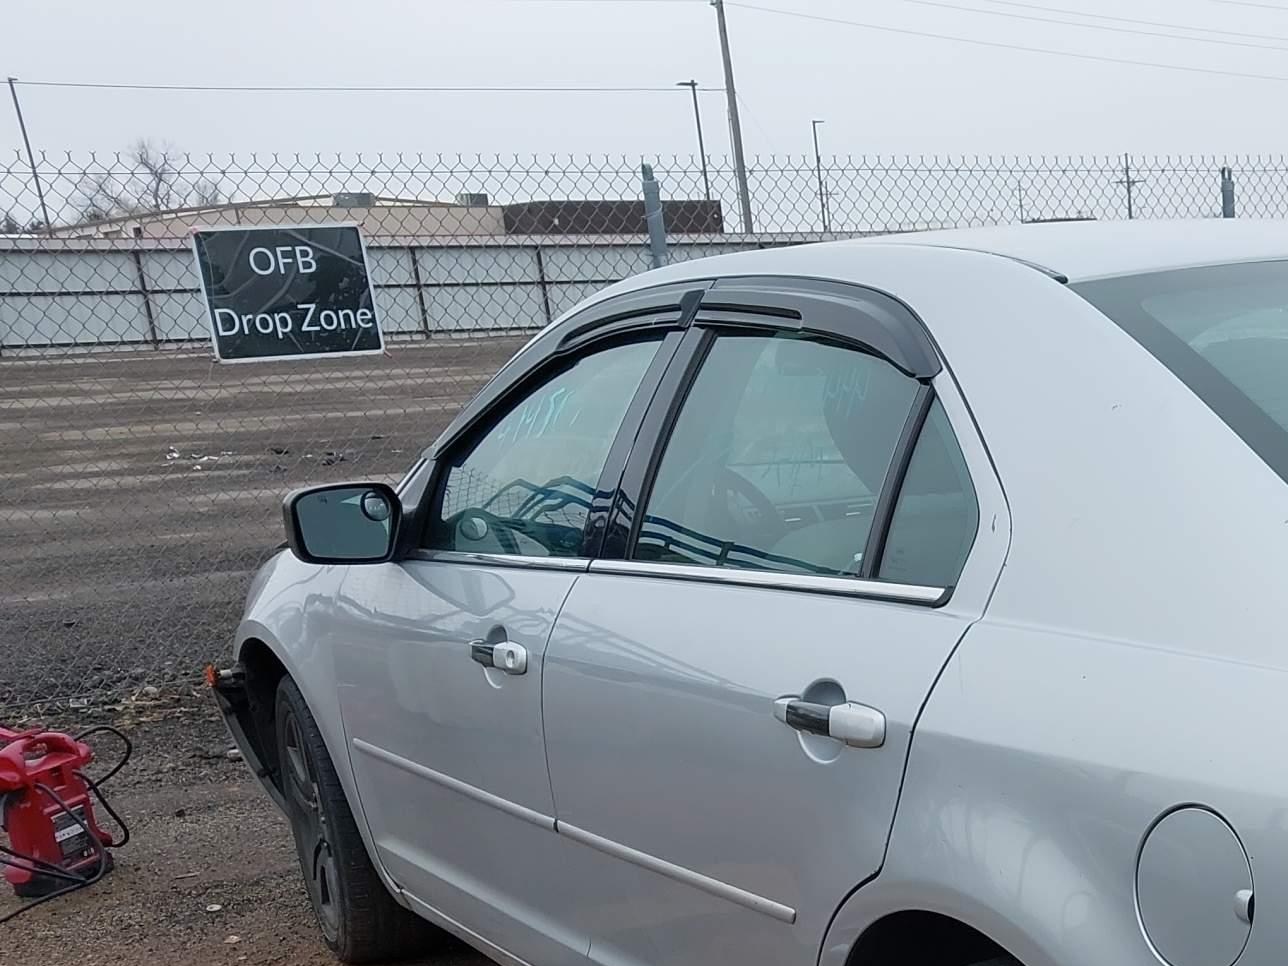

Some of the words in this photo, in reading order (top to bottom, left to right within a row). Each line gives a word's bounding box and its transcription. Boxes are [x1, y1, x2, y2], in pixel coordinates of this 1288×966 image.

[249, 246, 317, 275] OFB
[214, 308, 293, 339] Drop
[297, 303, 373, 332] Zone
